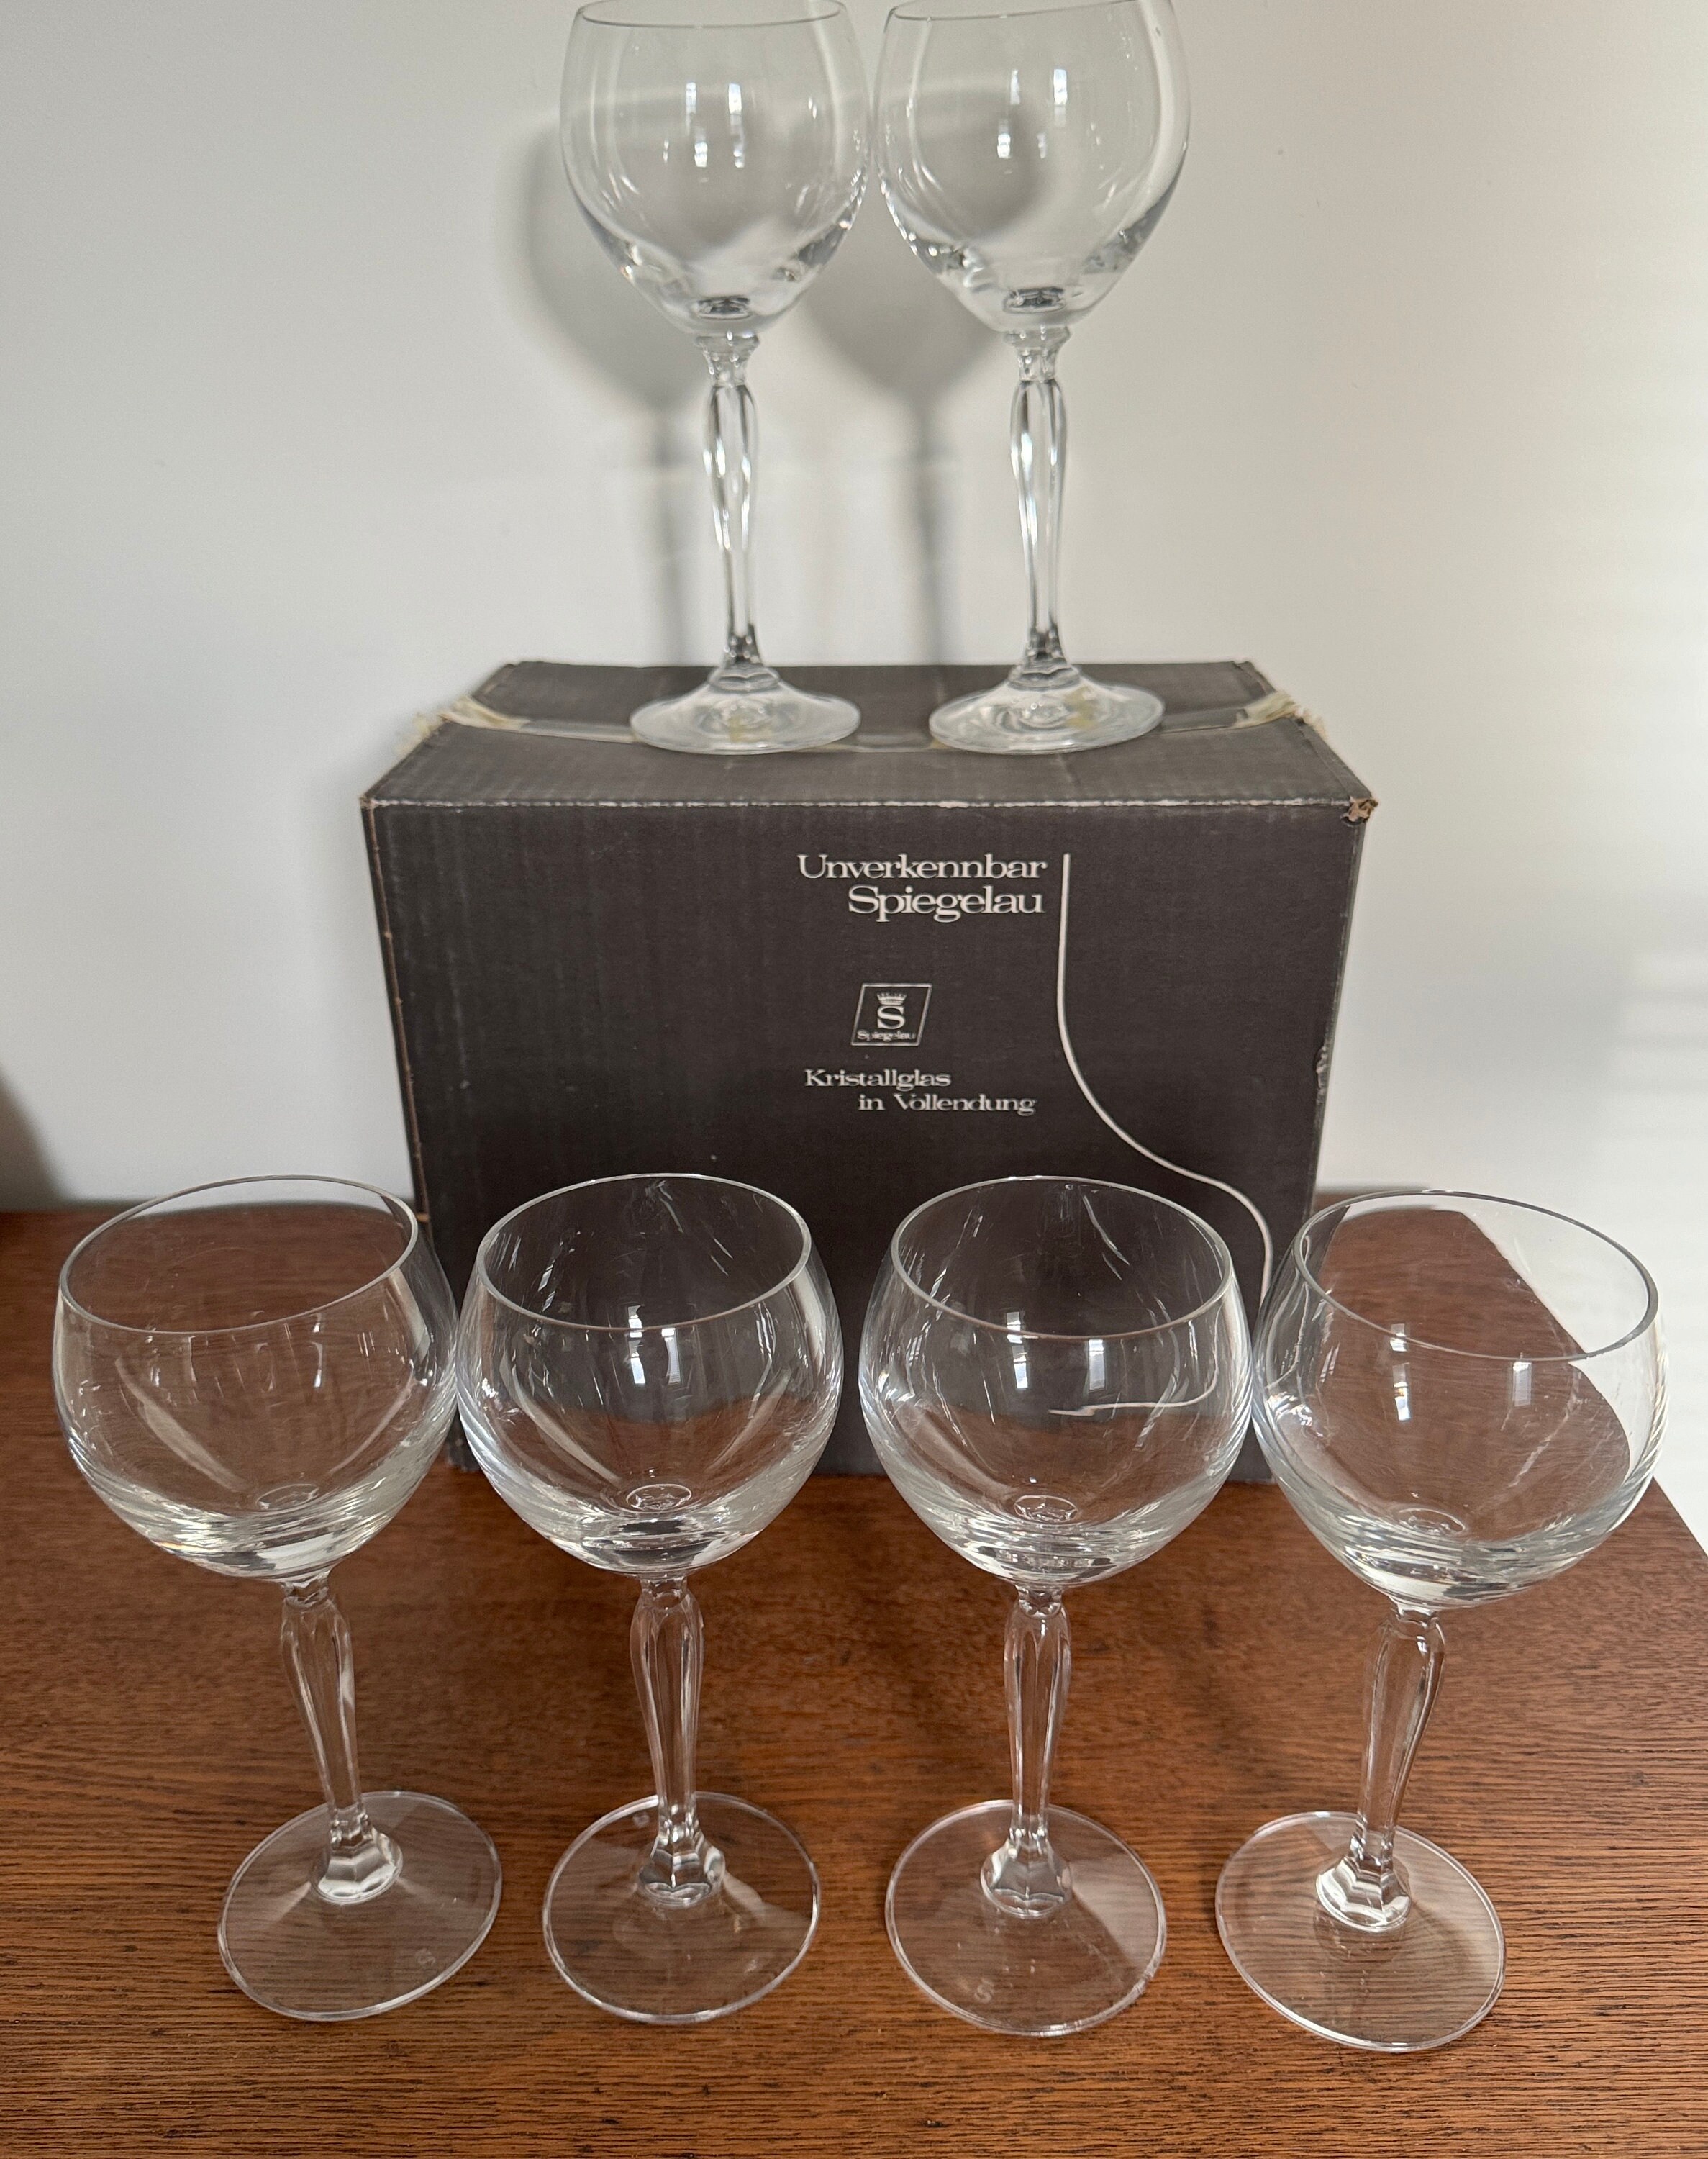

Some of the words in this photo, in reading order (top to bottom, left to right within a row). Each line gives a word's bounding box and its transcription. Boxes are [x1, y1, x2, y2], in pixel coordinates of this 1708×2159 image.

[796, 853, 1048, 879] Unverkennbar
[848, 884, 1045, 923] Spiegelau
[877, 1005, 906, 1030] S
[804, 1069, 952, 1092] Kristallglas
[858, 1095, 885, 1110] in
[894, 1093, 1037, 1116] Vollendung
